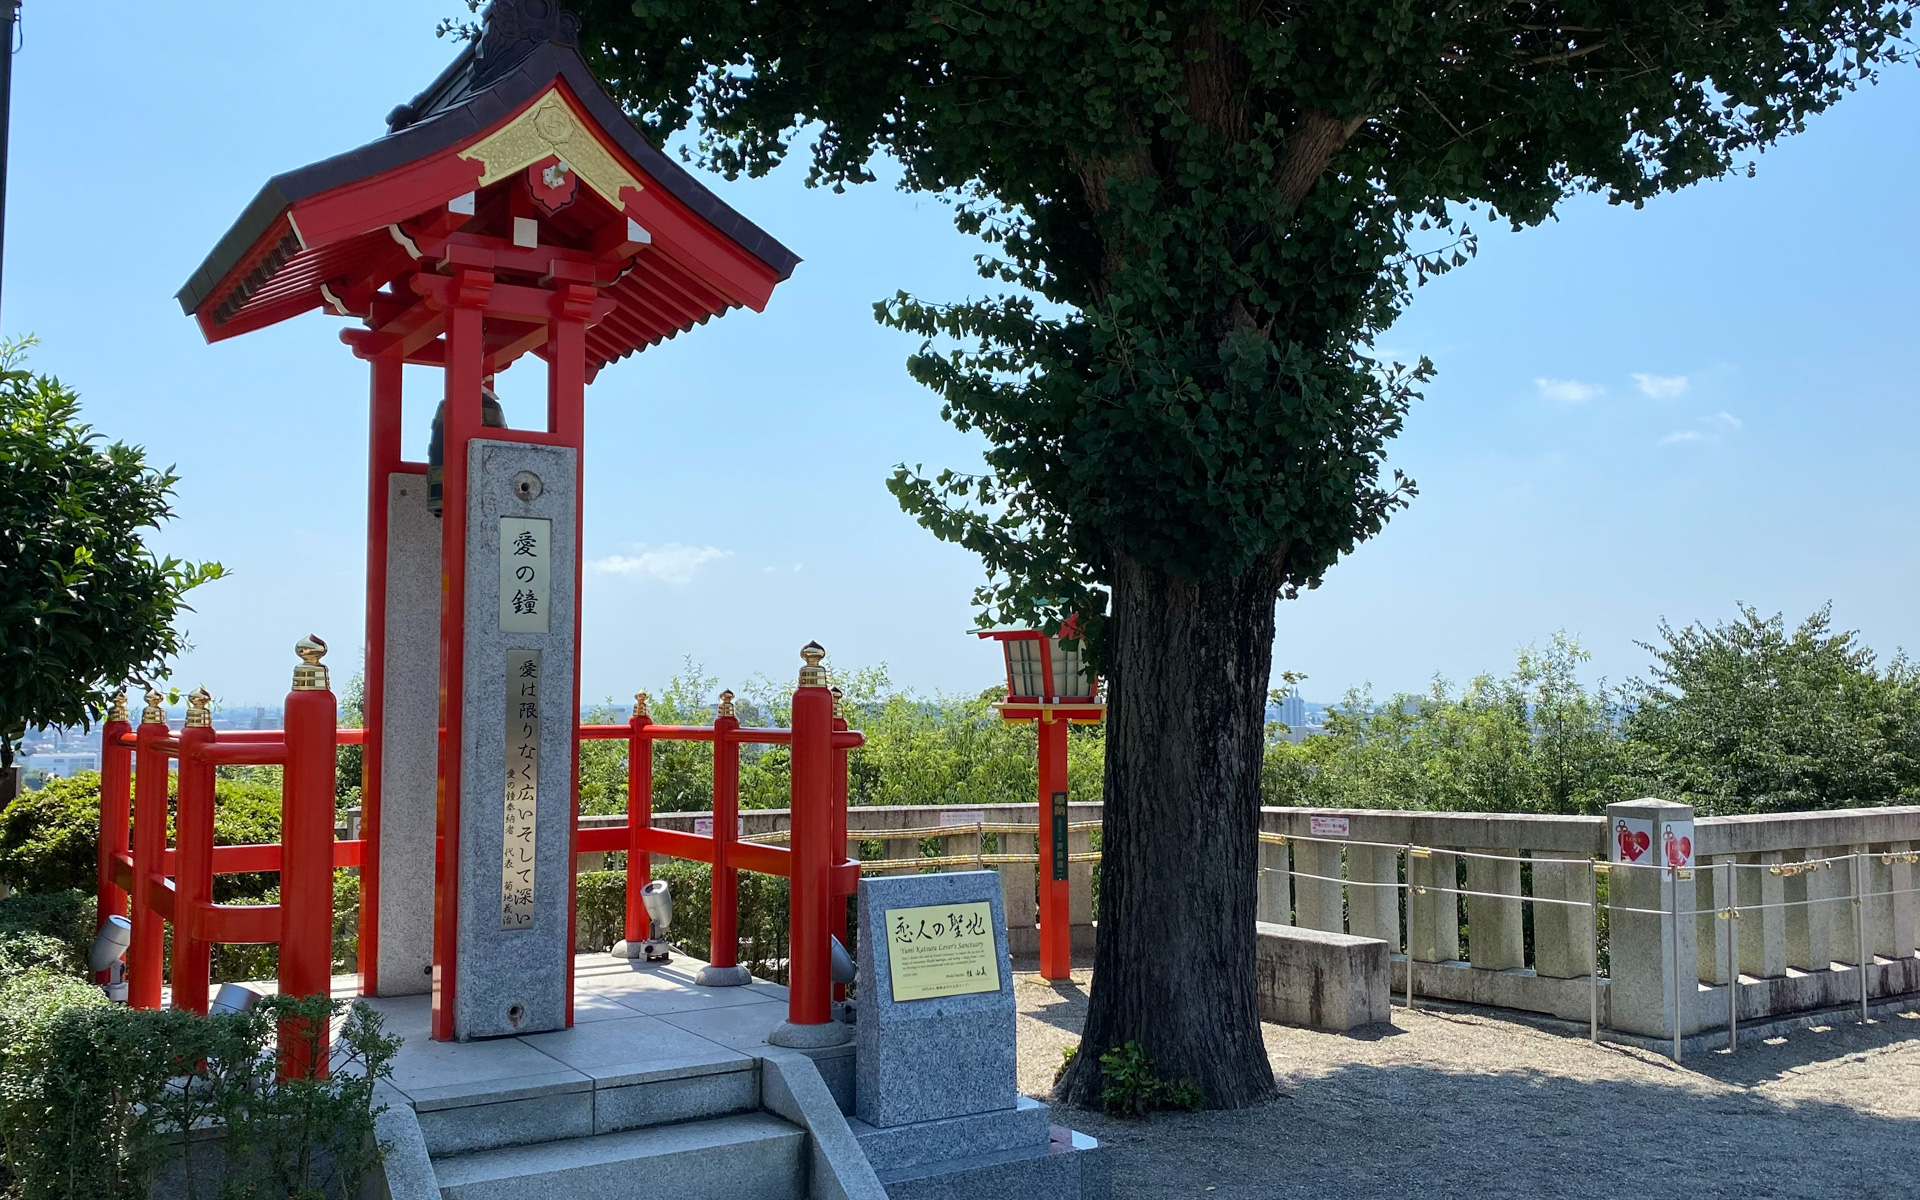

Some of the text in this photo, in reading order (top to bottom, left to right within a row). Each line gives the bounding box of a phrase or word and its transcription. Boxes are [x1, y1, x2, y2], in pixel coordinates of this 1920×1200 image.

[511, 531, 538, 615] 愛の鐘
[505, 768, 516, 835] 愛の鐘奉納者
[513, 659, 538, 925] 愛は限りなく広いそして深い
[504, 847, 515, 869] 代表
[895, 912, 985, 943] 恋人の聖地
[957, 941, 984, 950] Sanctuary
